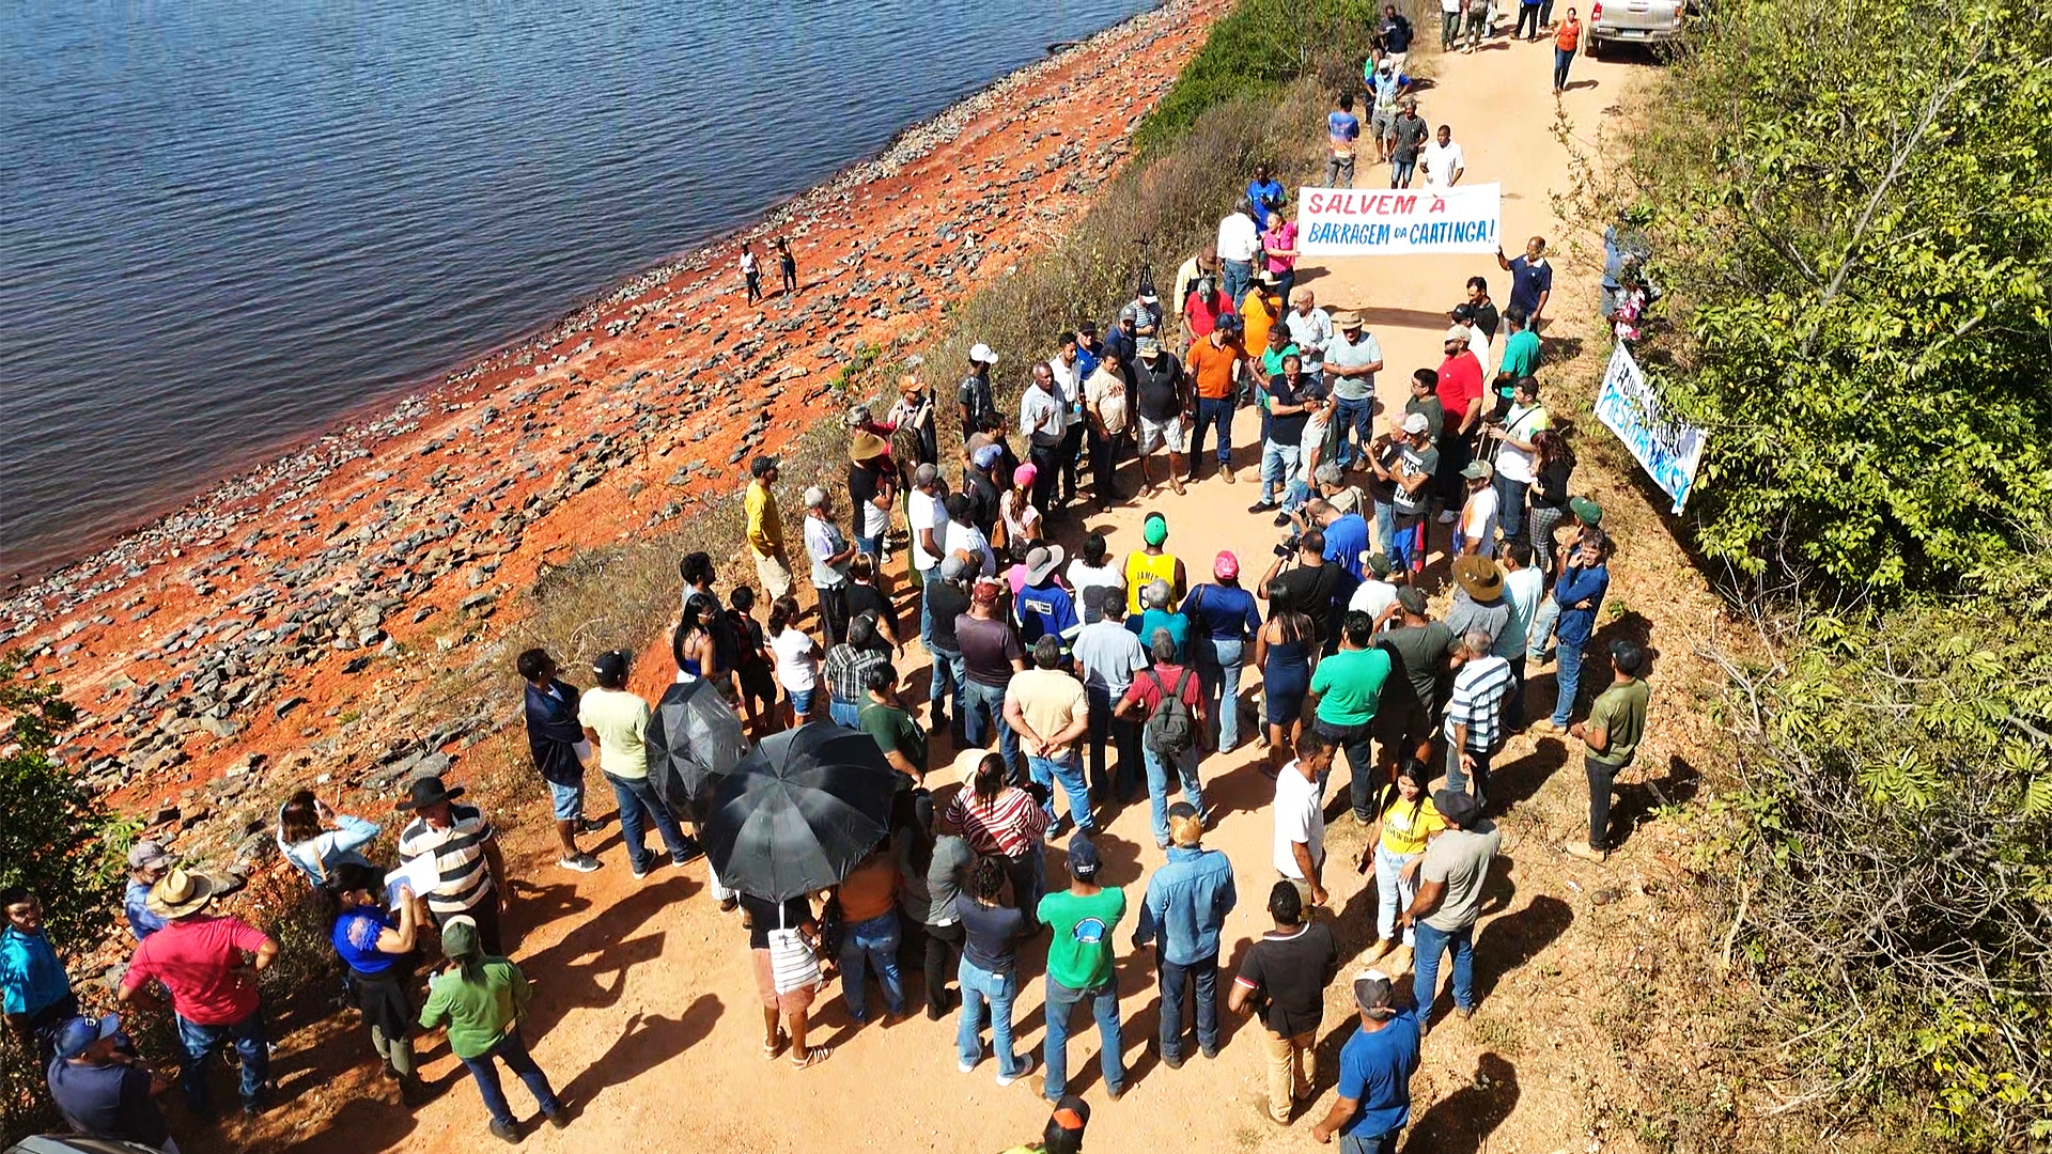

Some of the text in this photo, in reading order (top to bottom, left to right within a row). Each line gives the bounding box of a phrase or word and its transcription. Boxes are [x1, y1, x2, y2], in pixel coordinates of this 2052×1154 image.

[1308, 193, 1418, 215] SALVEM
[1308, 218, 1495, 245] BARRAGEM DA CAATINGA!
